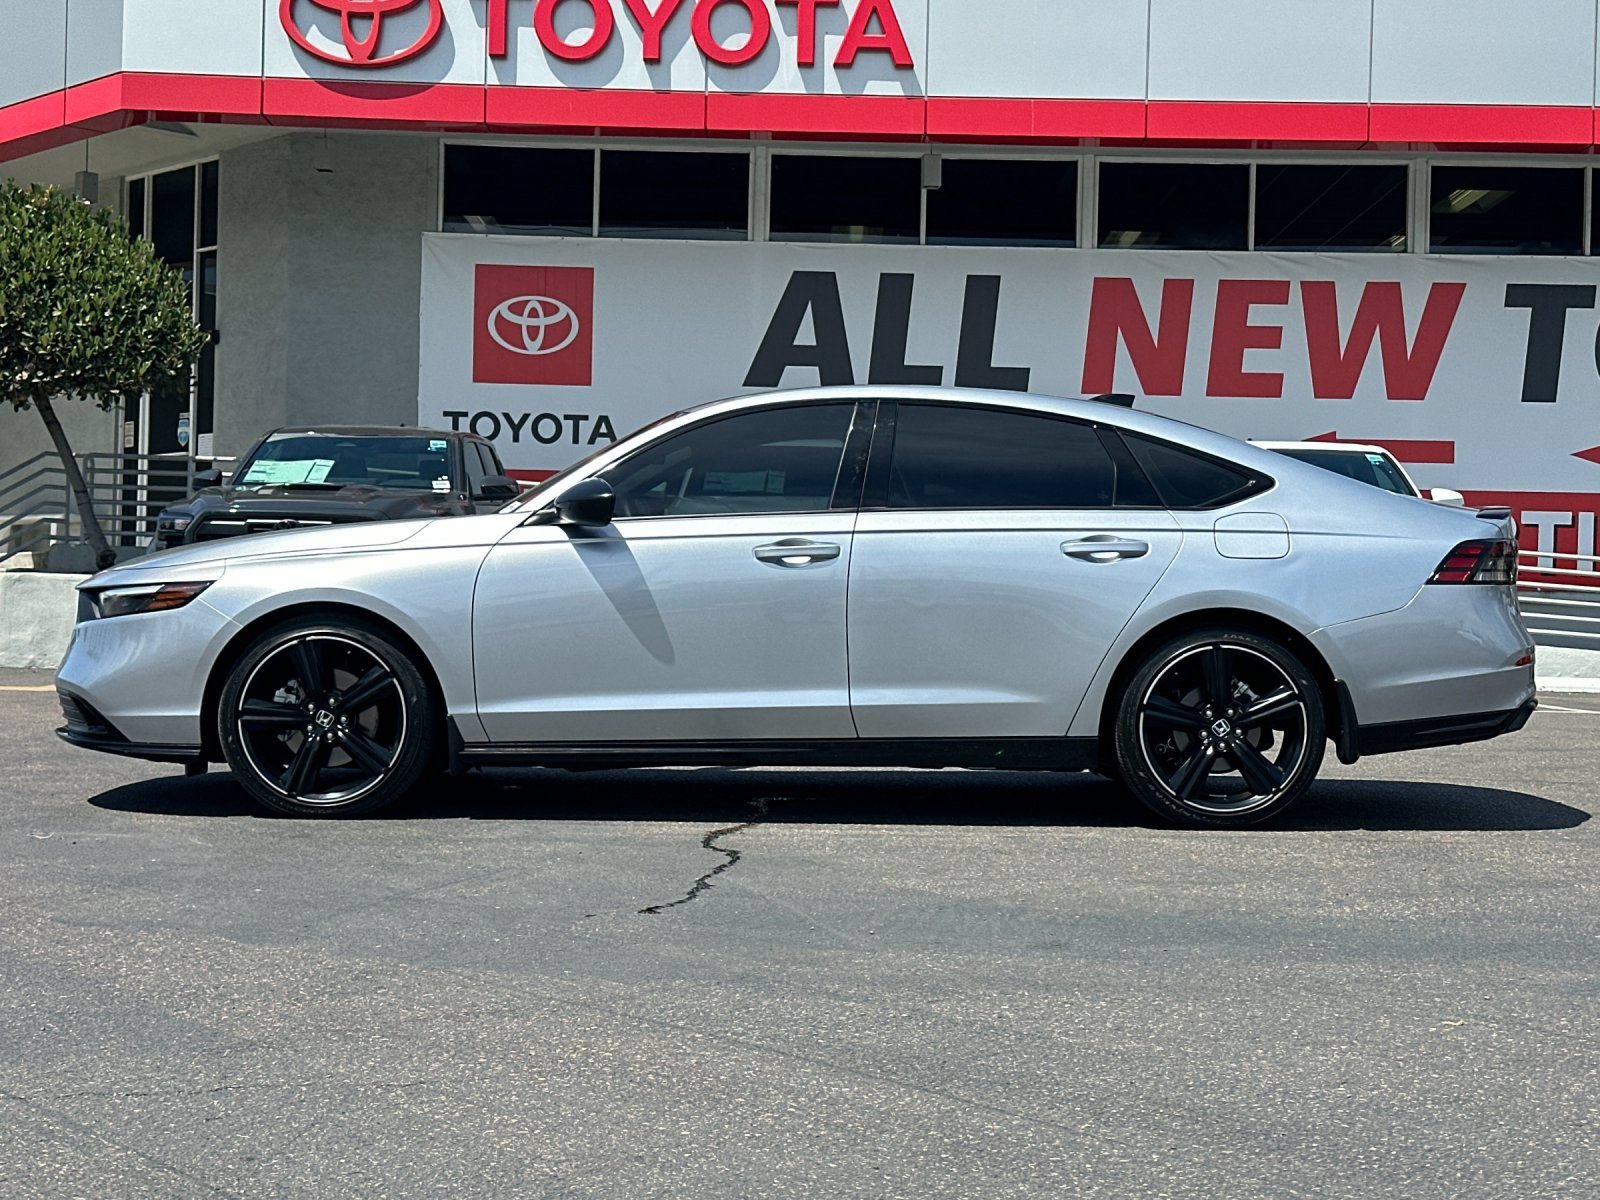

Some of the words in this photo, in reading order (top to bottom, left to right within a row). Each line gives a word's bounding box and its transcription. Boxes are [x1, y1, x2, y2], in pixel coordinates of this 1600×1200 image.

[742, 270, 1031, 392] ALL
[1081, 277, 1467, 401] NEW
[1503, 283, 1600, 403] T
[443, 410, 618, 445] TOYOTA
[1510, 510, 1595, 574] TI
